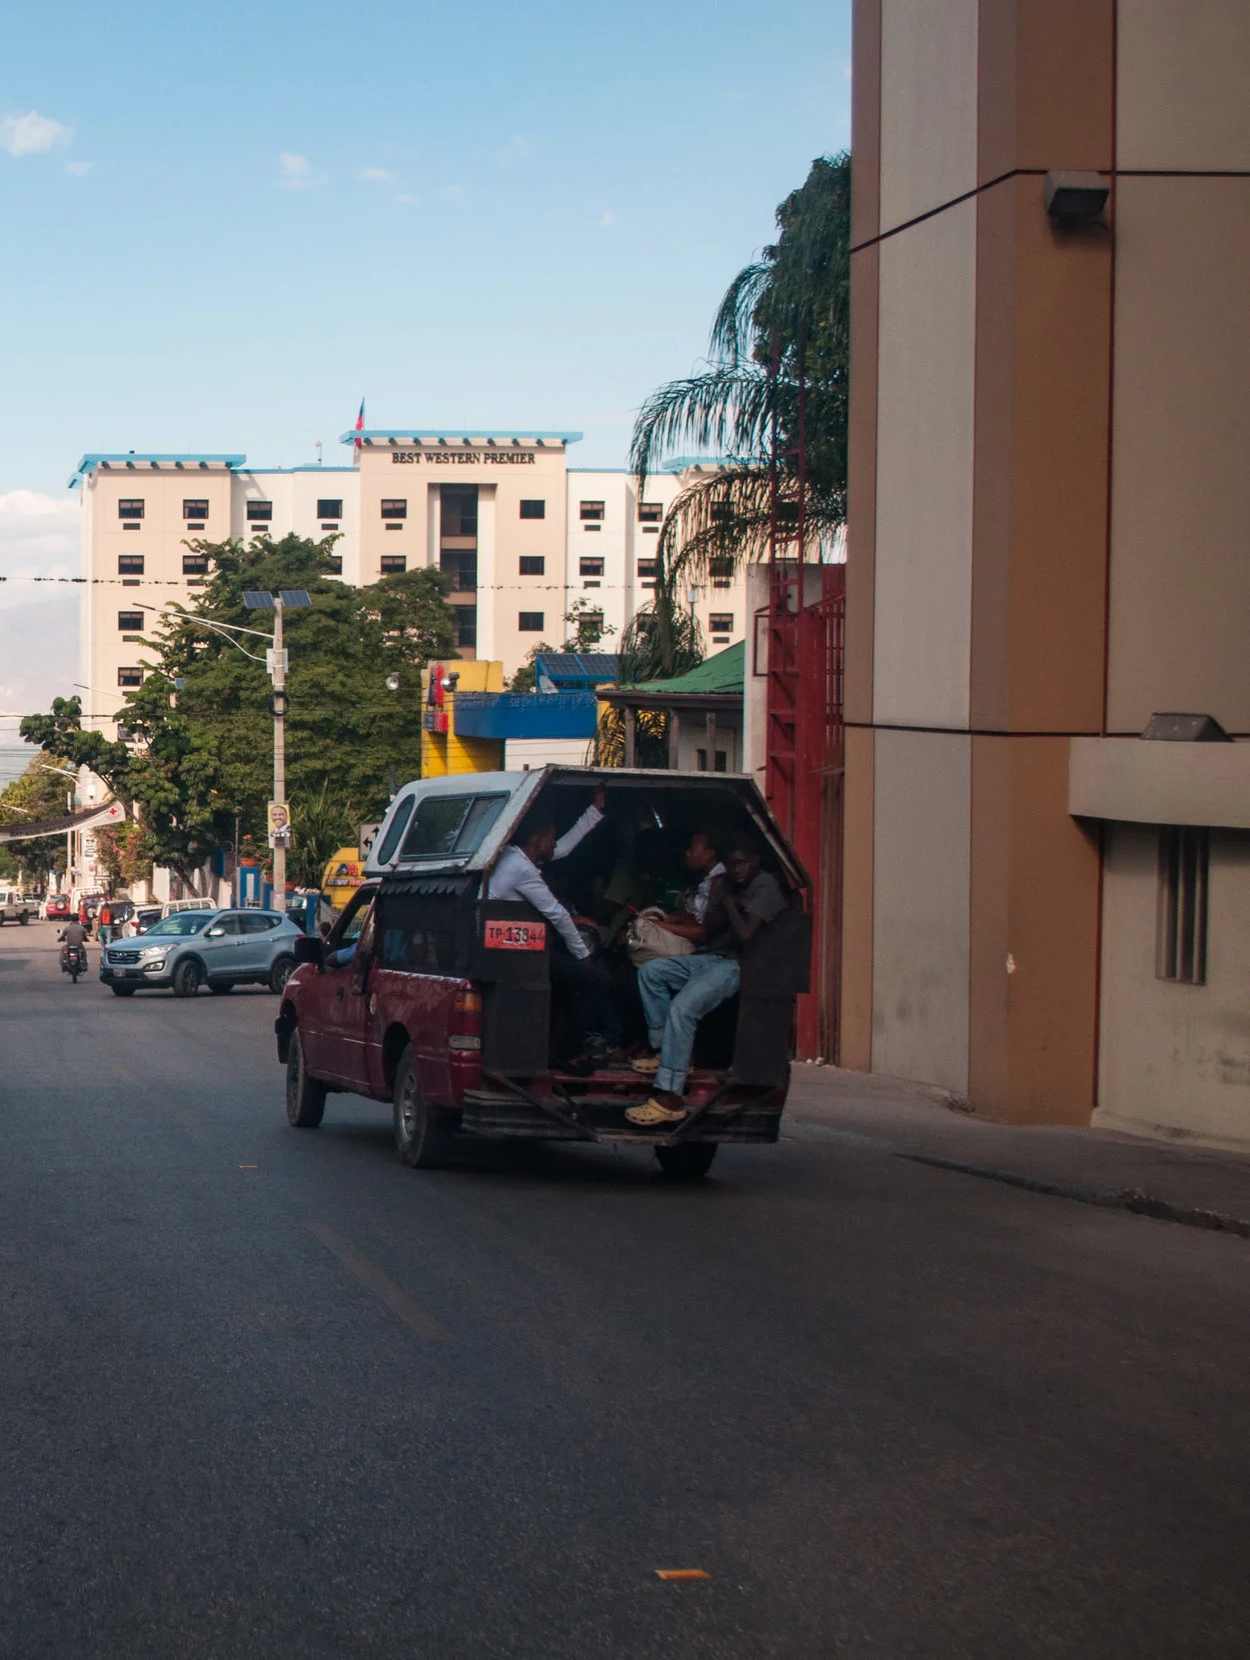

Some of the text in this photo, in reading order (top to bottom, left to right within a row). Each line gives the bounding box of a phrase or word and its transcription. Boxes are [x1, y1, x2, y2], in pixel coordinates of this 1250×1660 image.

[392, 452, 535, 464] BEST WESTERN PREMIER
